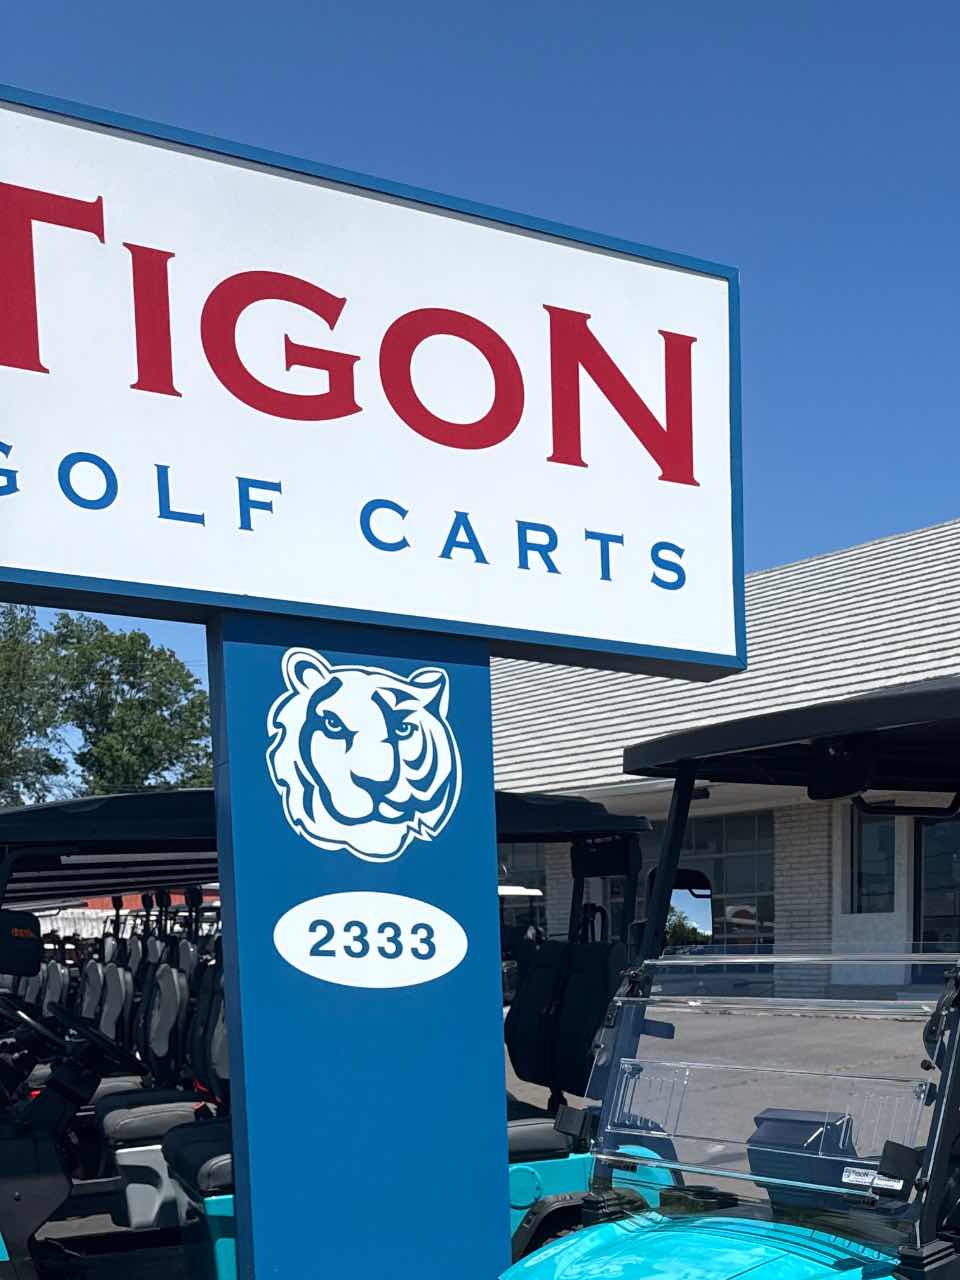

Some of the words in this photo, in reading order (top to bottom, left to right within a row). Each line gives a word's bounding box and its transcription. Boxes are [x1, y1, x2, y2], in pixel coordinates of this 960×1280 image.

[0, 180, 700, 487] TIGON
[359, 498, 688, 591] CARTS
[308, 919, 436, 960] 2333
